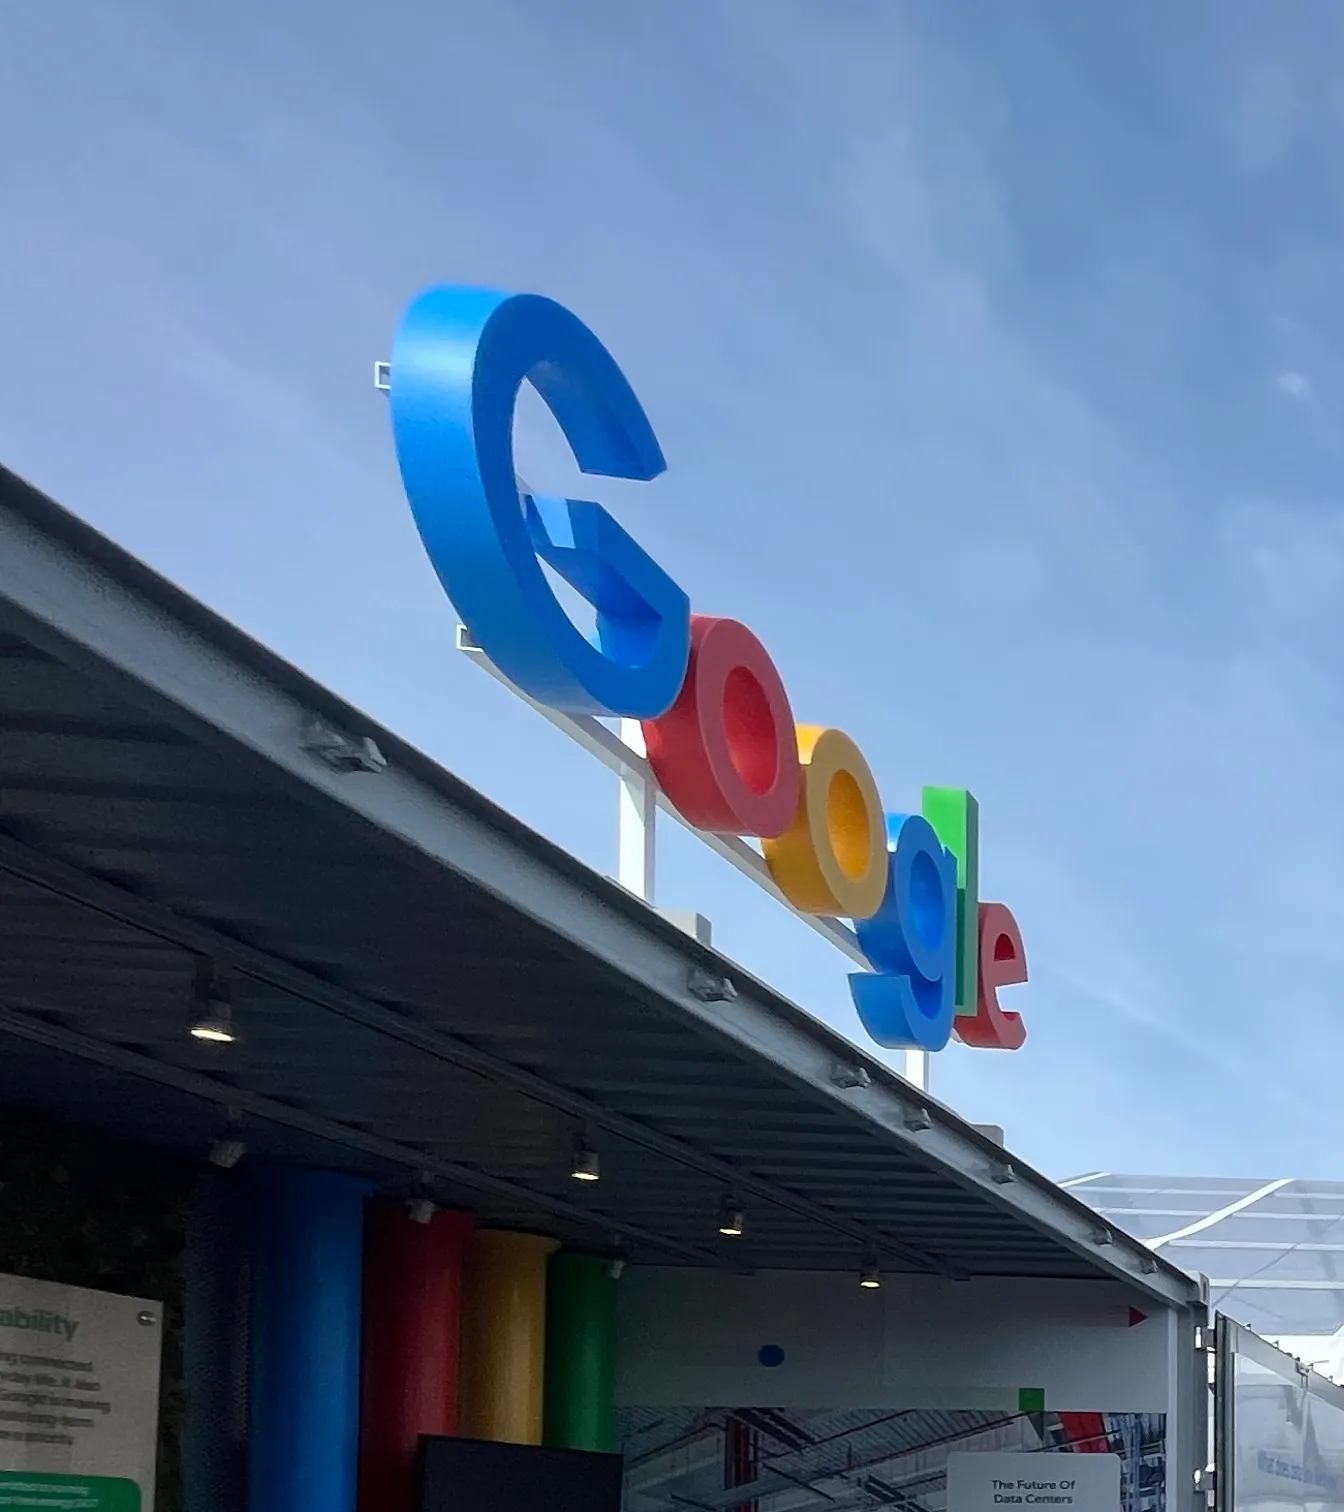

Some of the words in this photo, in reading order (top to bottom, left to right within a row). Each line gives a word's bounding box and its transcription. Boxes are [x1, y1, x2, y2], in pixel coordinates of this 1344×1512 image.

[390, 284, 1028, 1052] Google
[0, 1308, 80, 1343] ability
[992, 1479, 1014, 1490] The
[1017, 1479, 1057, 1490] Future
[1059, 1479, 1076, 1490] Of
[994, 1494, 1022, 1504] Data
[1025, 1494, 1073, 1504] Centers
